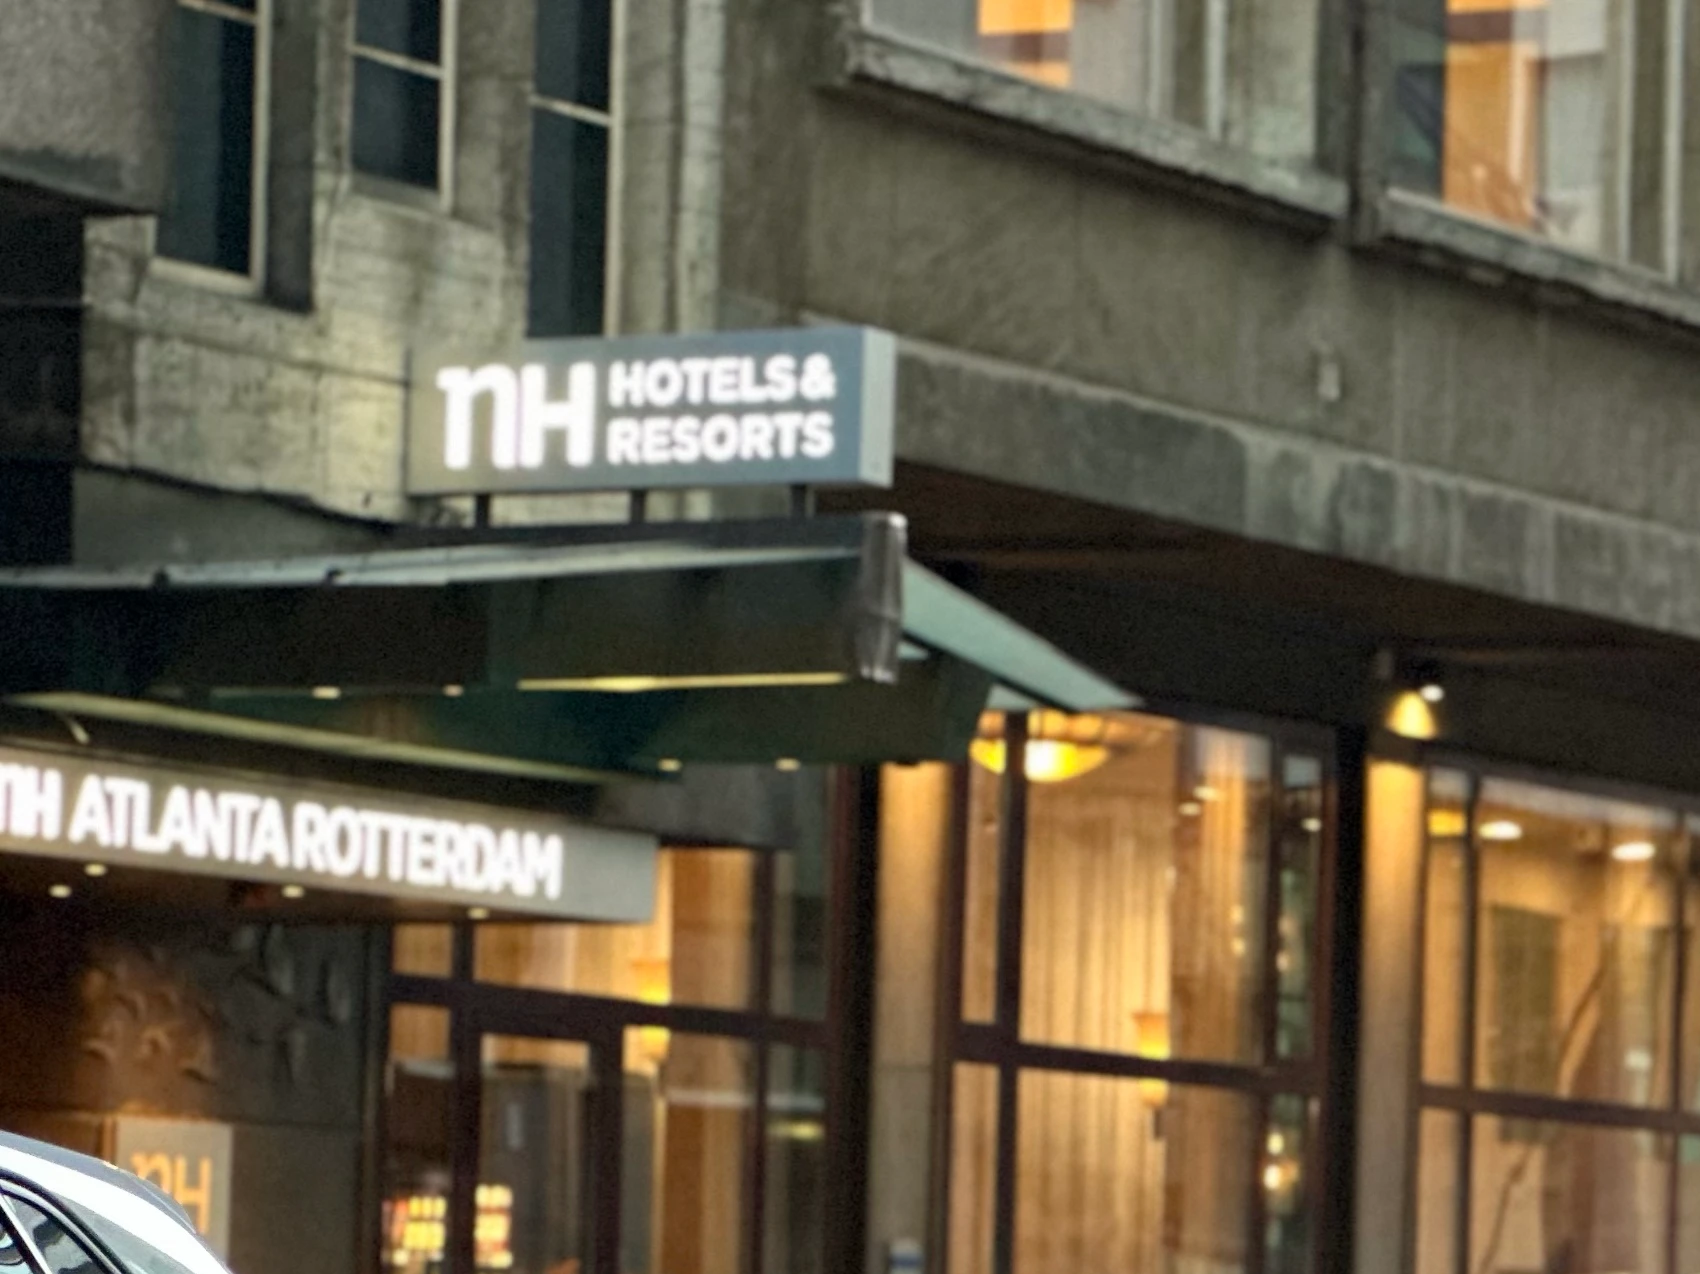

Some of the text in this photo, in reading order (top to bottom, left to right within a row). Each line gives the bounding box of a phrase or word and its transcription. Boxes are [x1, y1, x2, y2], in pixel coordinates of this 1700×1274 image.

[607, 411, 835, 464] RESORTS
[67, 772, 290, 869] ATLANTA
[291, 801, 564, 900] ROTTERDAM
